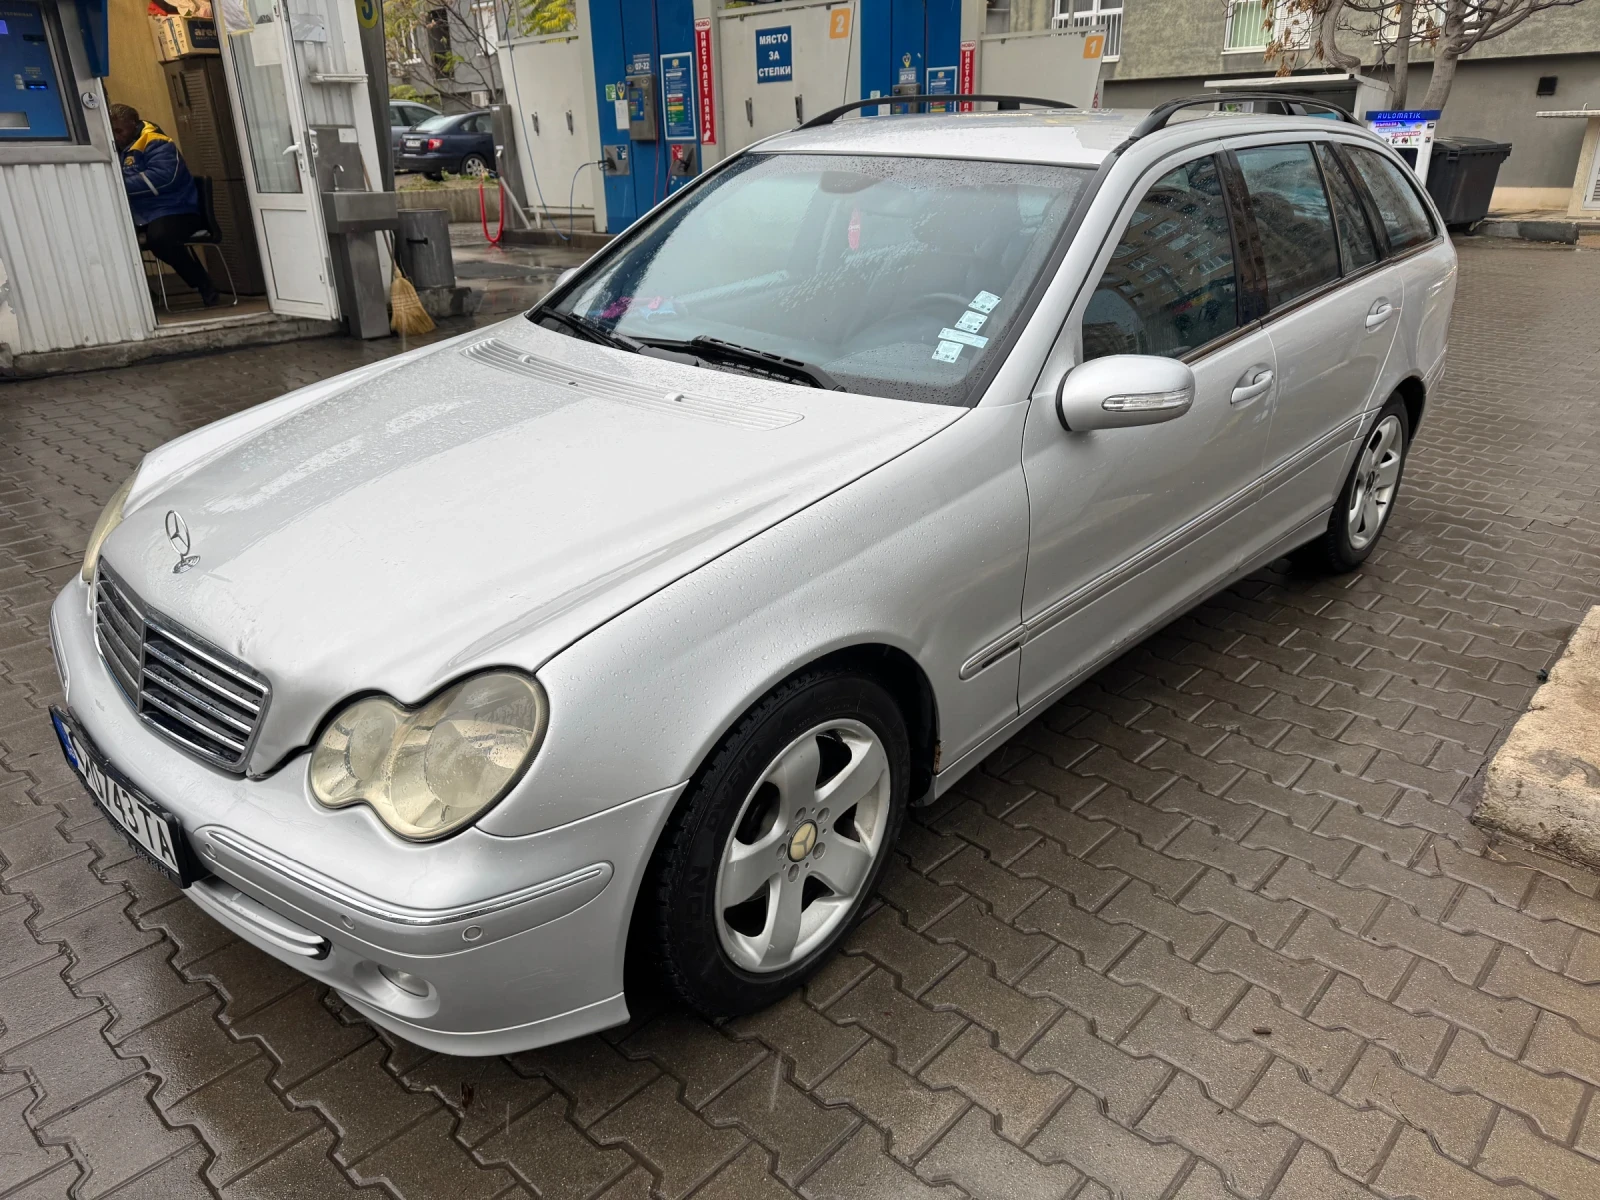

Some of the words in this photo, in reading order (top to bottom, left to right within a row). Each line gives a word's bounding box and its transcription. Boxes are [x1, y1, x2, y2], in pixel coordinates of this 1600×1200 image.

[695, 20, 710, 28] НОВО
[835, 14, 845, 33] 2
[759, 33, 788, 45] МЯСТО
[1090, 39, 1097, 54] 1
[768, 50, 780, 60] ЗА
[700, 31, 709, 95] ПИСТОЛЕТ
[758, 65, 791, 77] СТЕЛКИ
[703, 97, 711, 129] ПЯНА
